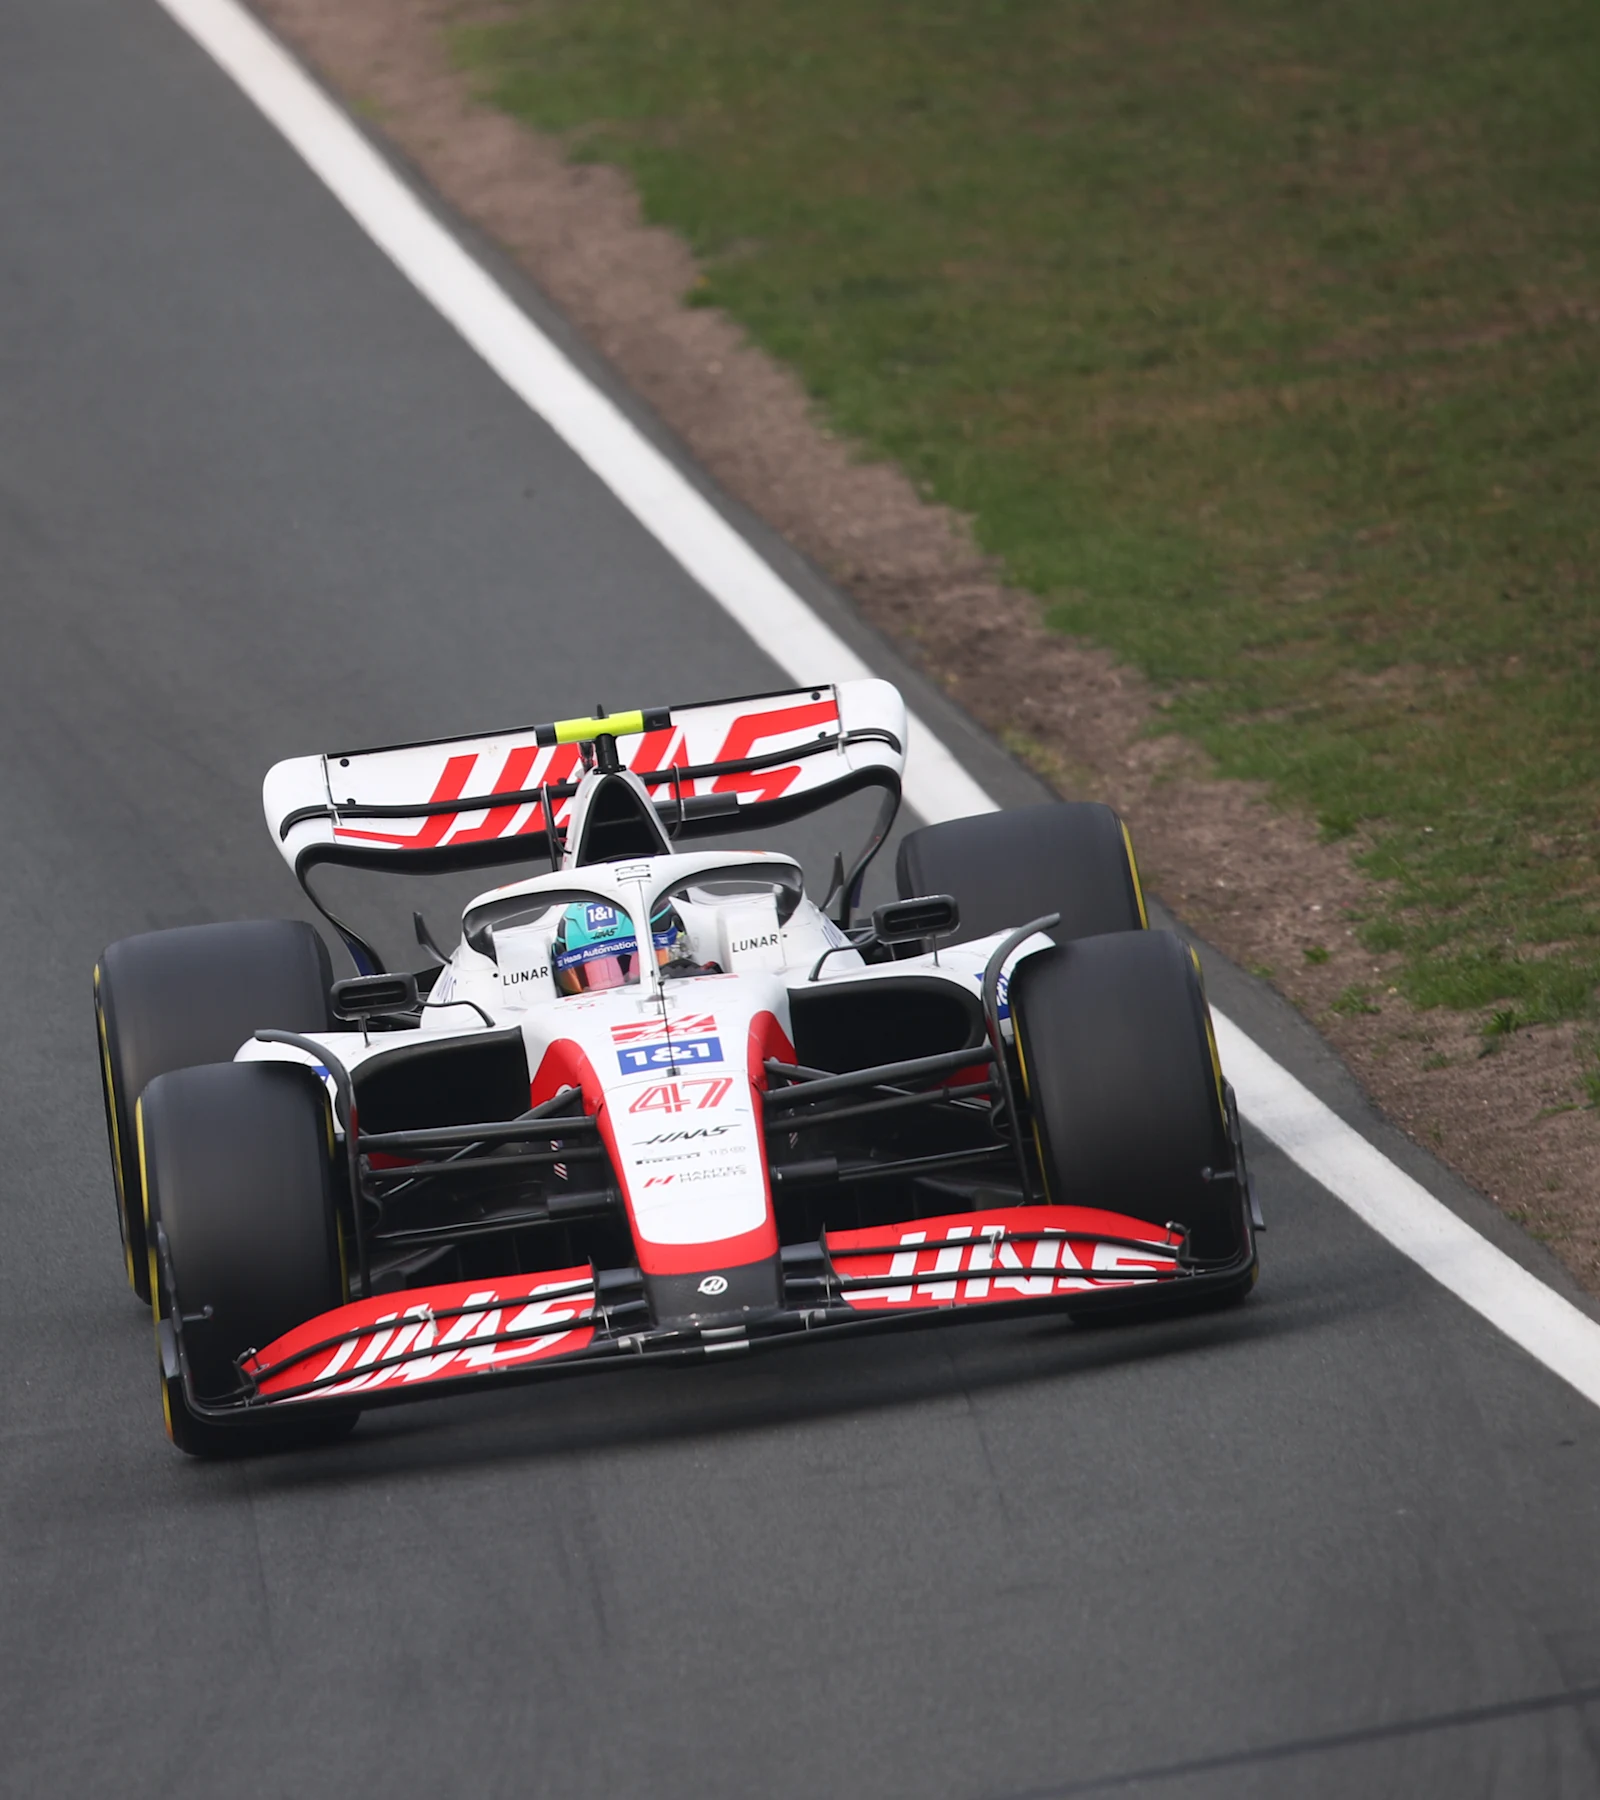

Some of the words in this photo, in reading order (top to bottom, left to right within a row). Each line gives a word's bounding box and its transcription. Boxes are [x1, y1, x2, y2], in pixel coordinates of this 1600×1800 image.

[587, 905, 614, 923] 1&1
[563, 953, 582, 965] Haas
[583, 940, 638, 959] Automation
[731, 933, 779, 953] LUNAR
[502, 966, 549, 986] LUNAR
[625, 1042, 711, 1066] 1&1
[628, 1077, 734, 1114] 47
[632, 1124, 741, 1146] HAAS
